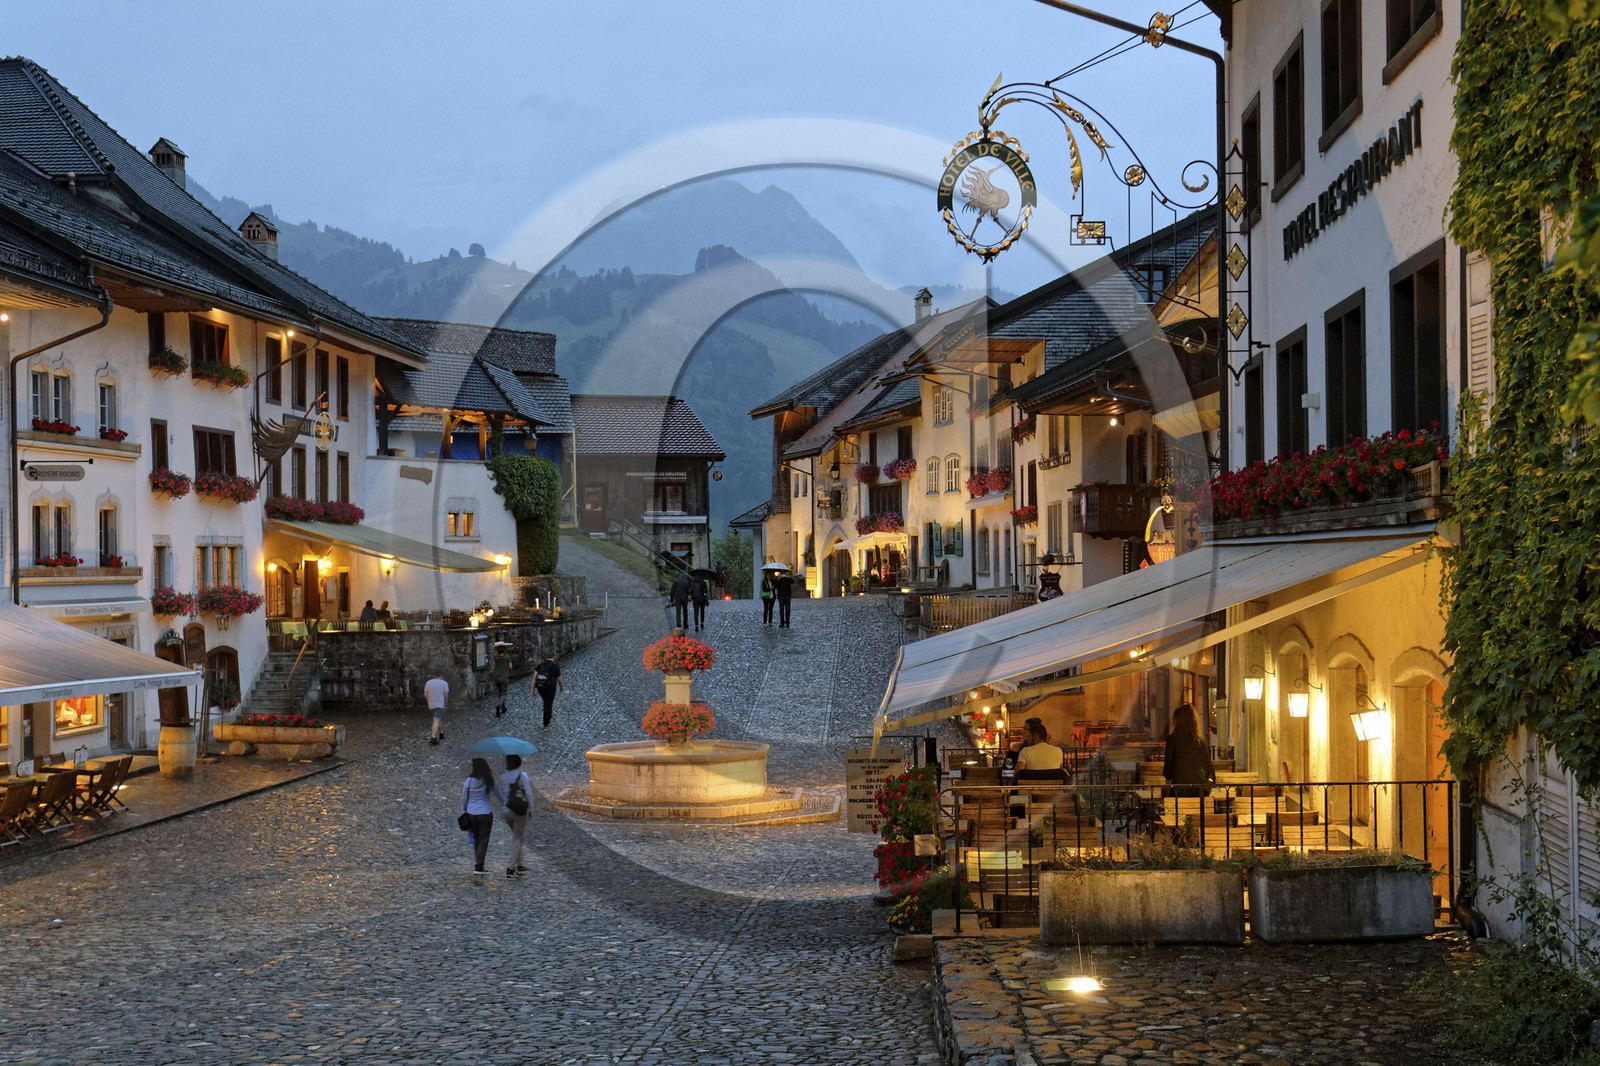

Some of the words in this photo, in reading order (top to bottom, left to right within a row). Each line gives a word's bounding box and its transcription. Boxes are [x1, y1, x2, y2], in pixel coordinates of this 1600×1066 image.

[939, 150, 976, 196] HOTEL
[977, 143, 1003, 157] DE
[1005, 150, 1034, 192] VILLE
[1283, 202, 1320, 261] HOTEL
[1318, 99, 1423, 230] RESTAURANT
[60, 470, 80, 478] ROOMS
